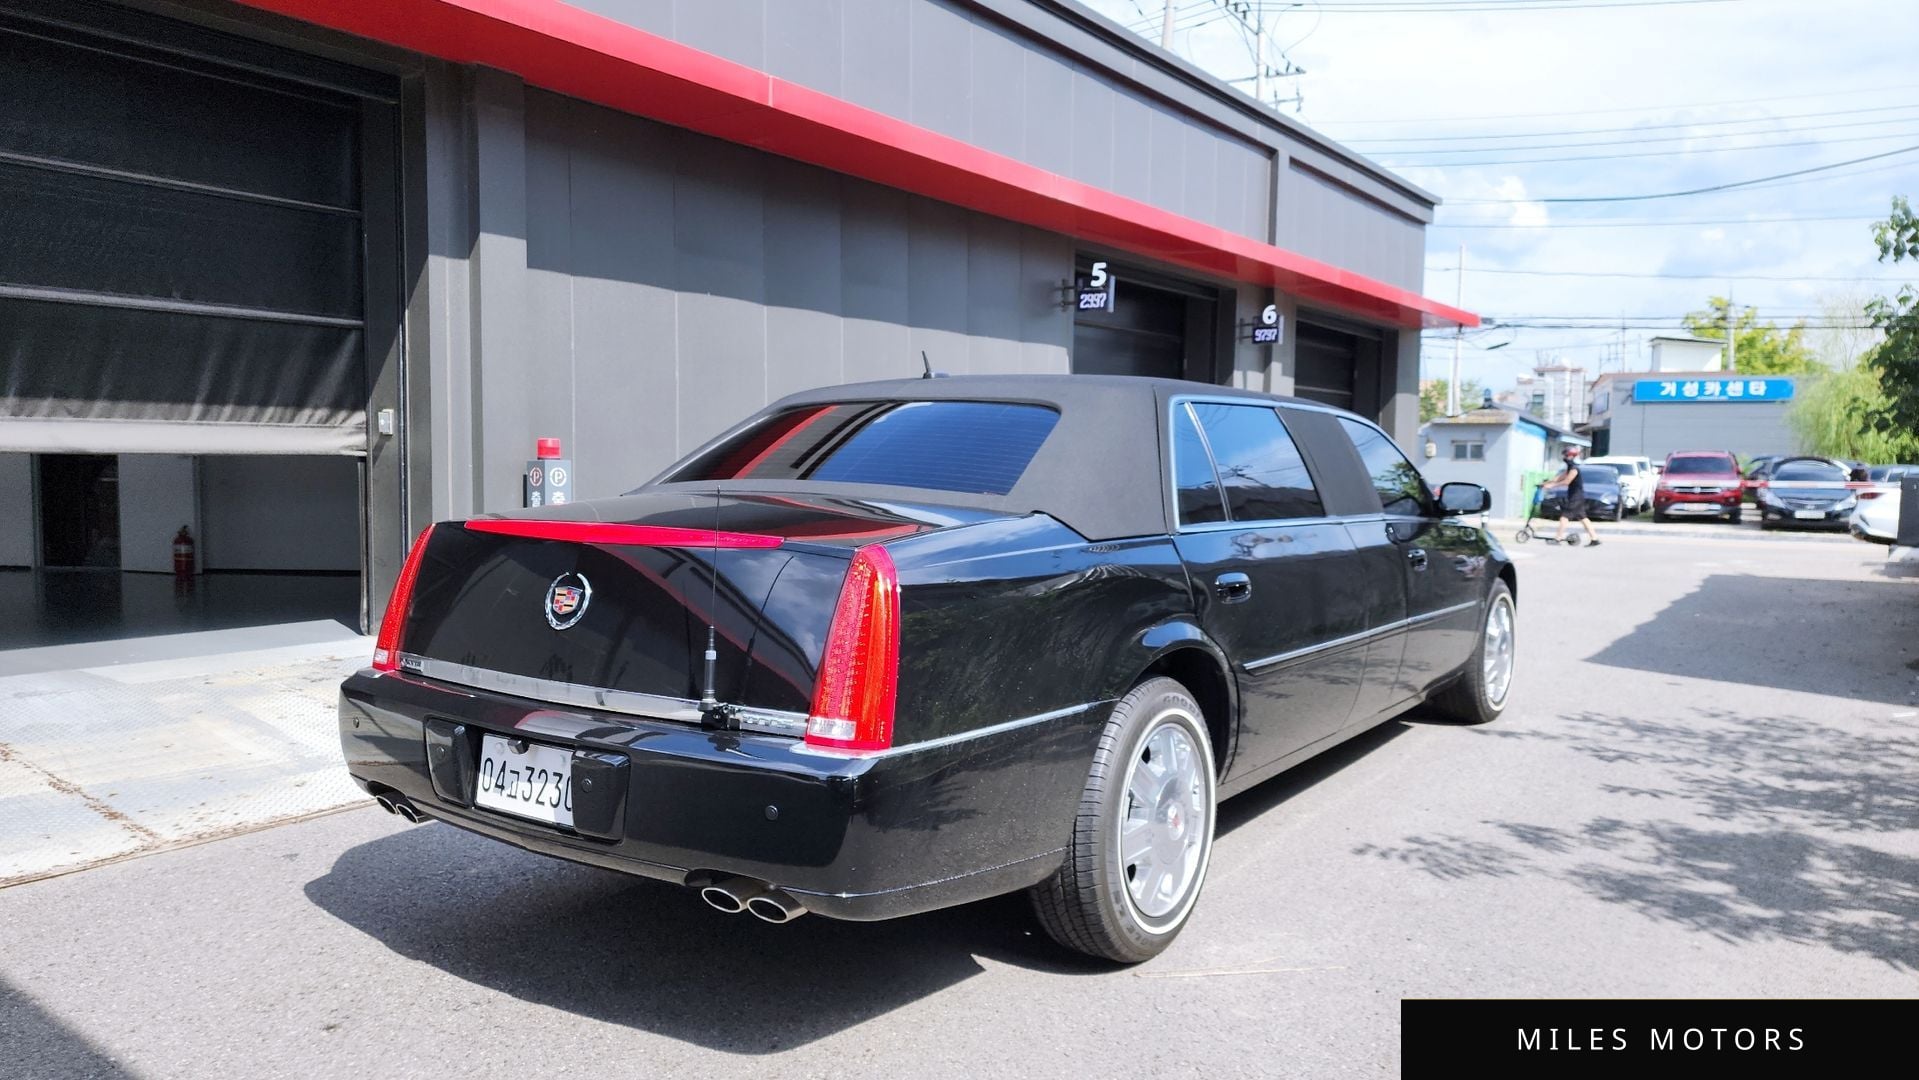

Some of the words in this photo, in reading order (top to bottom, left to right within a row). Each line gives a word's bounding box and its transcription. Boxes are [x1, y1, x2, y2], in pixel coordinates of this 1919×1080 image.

[1090, 262, 1107, 287] 5
[1079, 292, 1107, 309] 2997
[1262, 304, 1277, 325] 6
